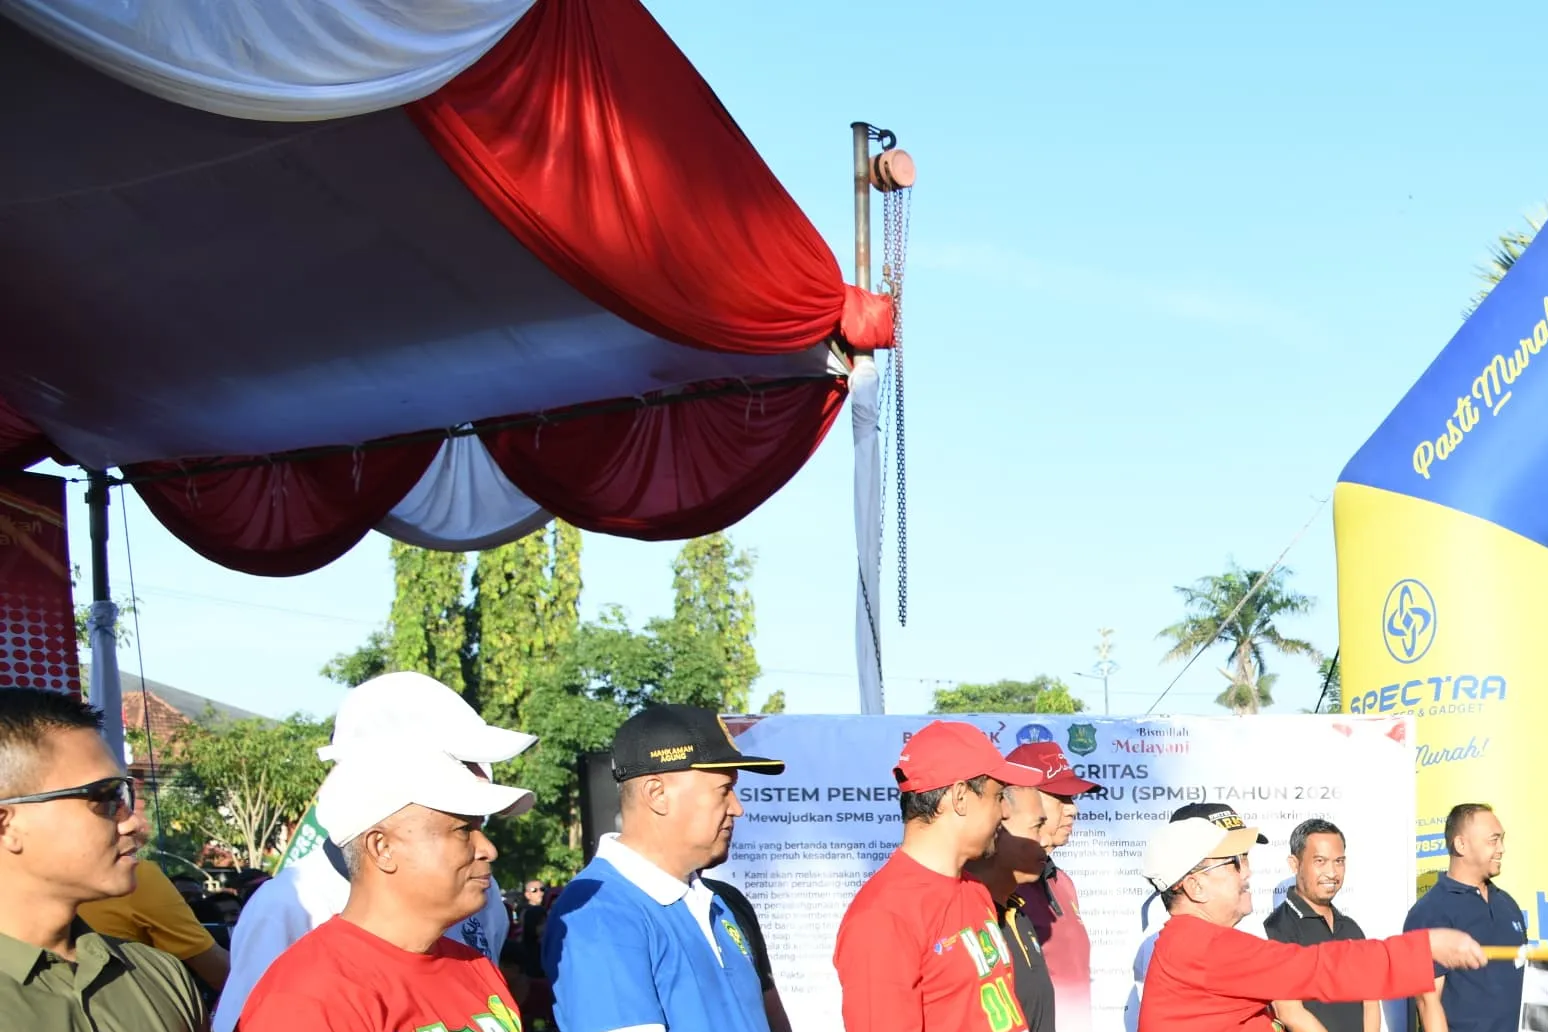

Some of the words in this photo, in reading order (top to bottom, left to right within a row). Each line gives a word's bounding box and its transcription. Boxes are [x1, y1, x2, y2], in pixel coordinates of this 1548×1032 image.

[1412, 396, 1480, 479] Pasti
[1350, 675, 1507, 714] SPECTRA
[1428, 703, 1484, 716] GADGET
[1111, 738, 1190, 756] Melayani
[661, 753, 687, 763] AGUNG
[1073, 764, 1149, 780] GRITAS
[740, 787, 820, 802] SISTEM
[827, 787, 901, 802] PENER
[1074, 786, 1126, 801] ARU
[1132, 784, 1208, 803] (SPMB)
[1215, 786, 1288, 800] TAHUN
[836, 812, 875, 822] SPMB
[877, 814, 902, 824] yan
[732, 841, 755, 849] Kami
[758, 842, 782, 851] yang
[784, 841, 828, 849] bertanda
[830, 842, 866, 850] tangan
[868, 840, 877, 849] di
[879, 840, 901, 849] baw
[731, 852, 767, 861] dengan
[770, 852, 800, 861] penuh
[857, 852, 891, 861] tanggu
